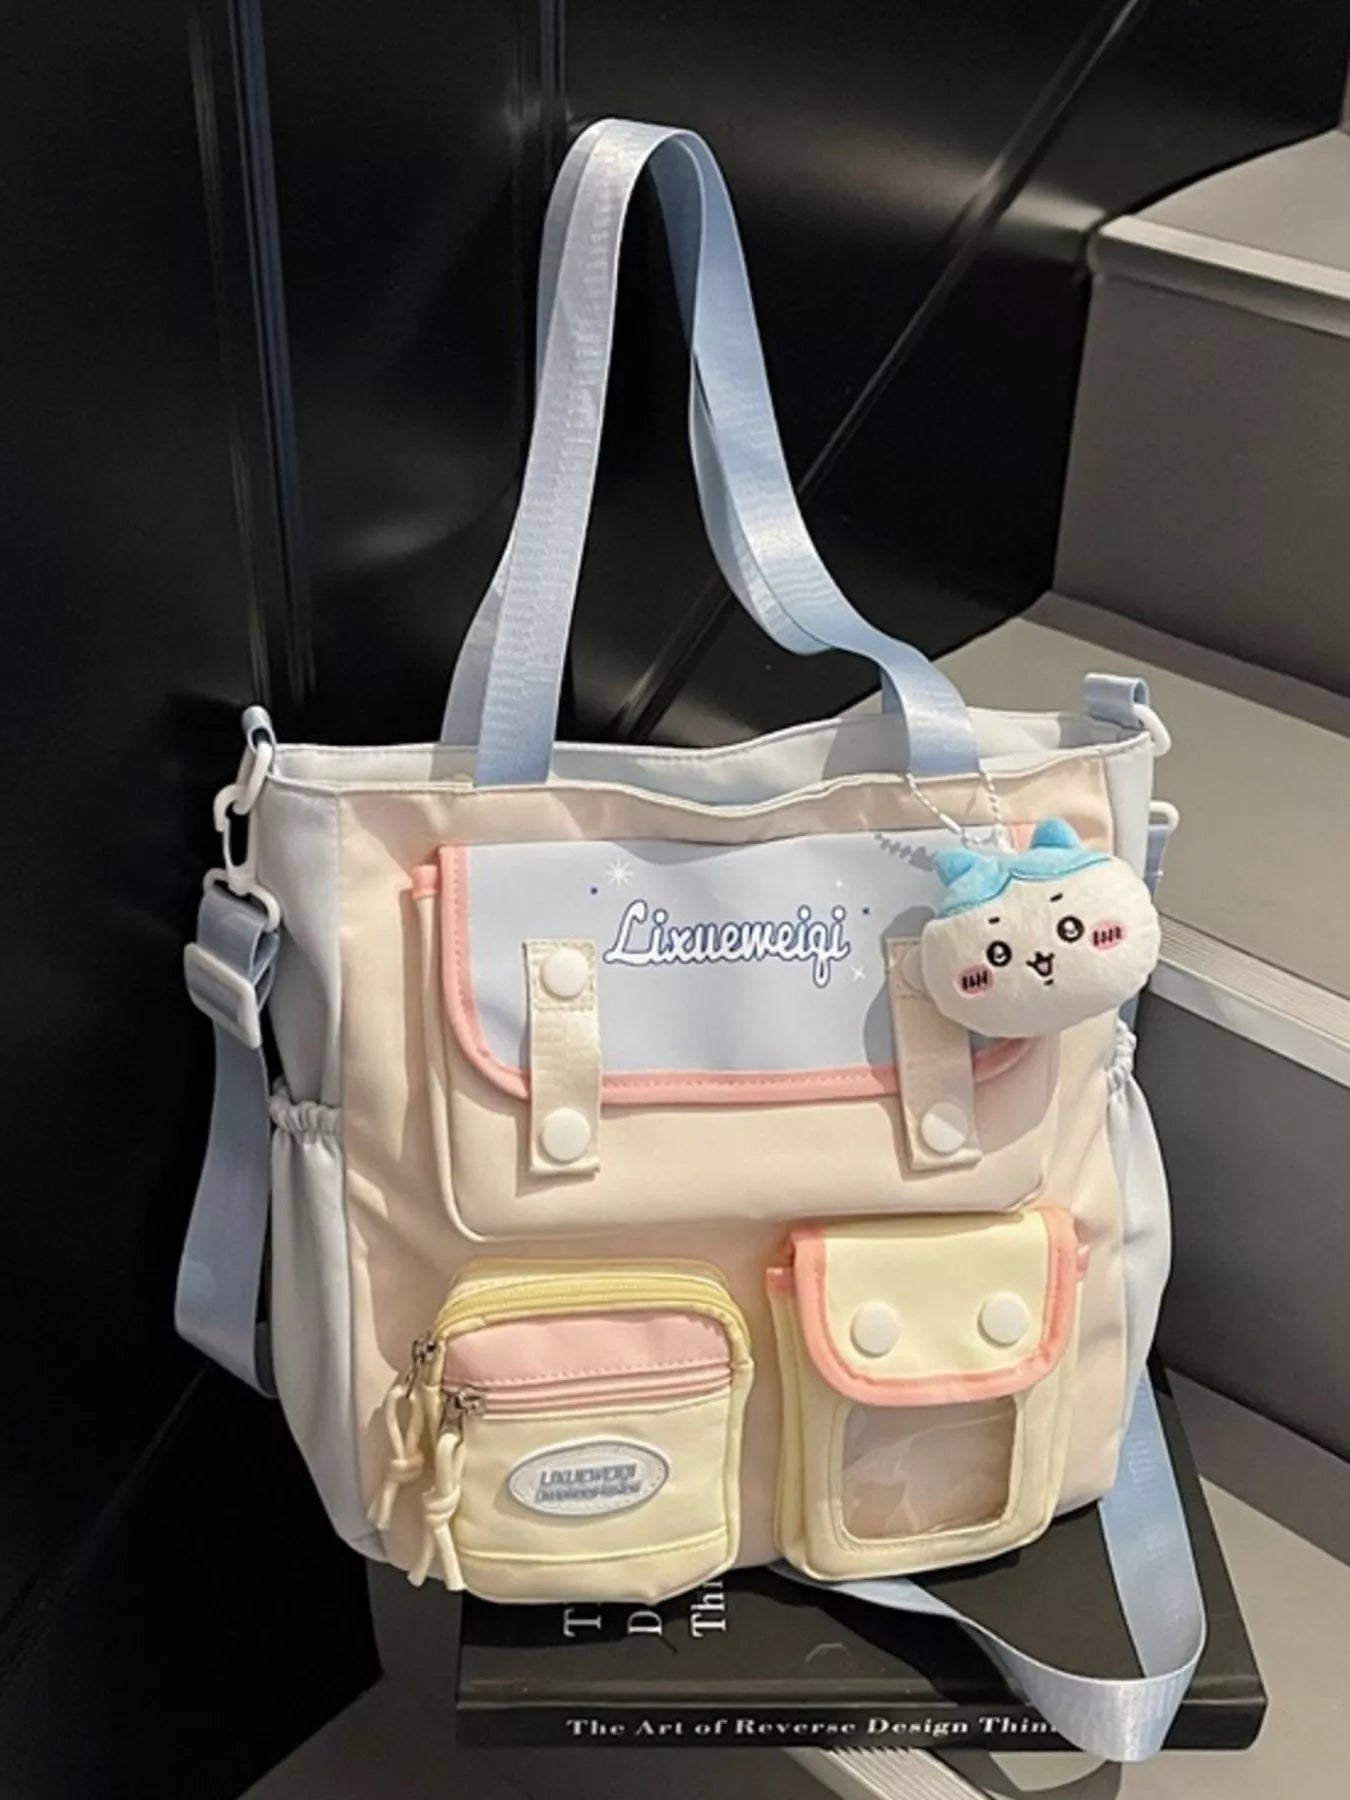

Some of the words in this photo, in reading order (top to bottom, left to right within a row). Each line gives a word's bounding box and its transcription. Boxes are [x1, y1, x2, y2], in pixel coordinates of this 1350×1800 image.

[603, 899, 851, 989] Lixueweiqi
[563, 1606, 602, 1638] T
[566, 1718, 625, 1736] The
[635, 1719, 683, 1736] Art
[694, 1718, 729, 1735] of
[735, 1718, 857, 1735] Reverse
[867, 1716, 969, 1738] Design
[978, 1716, 1057, 1733] Thin
